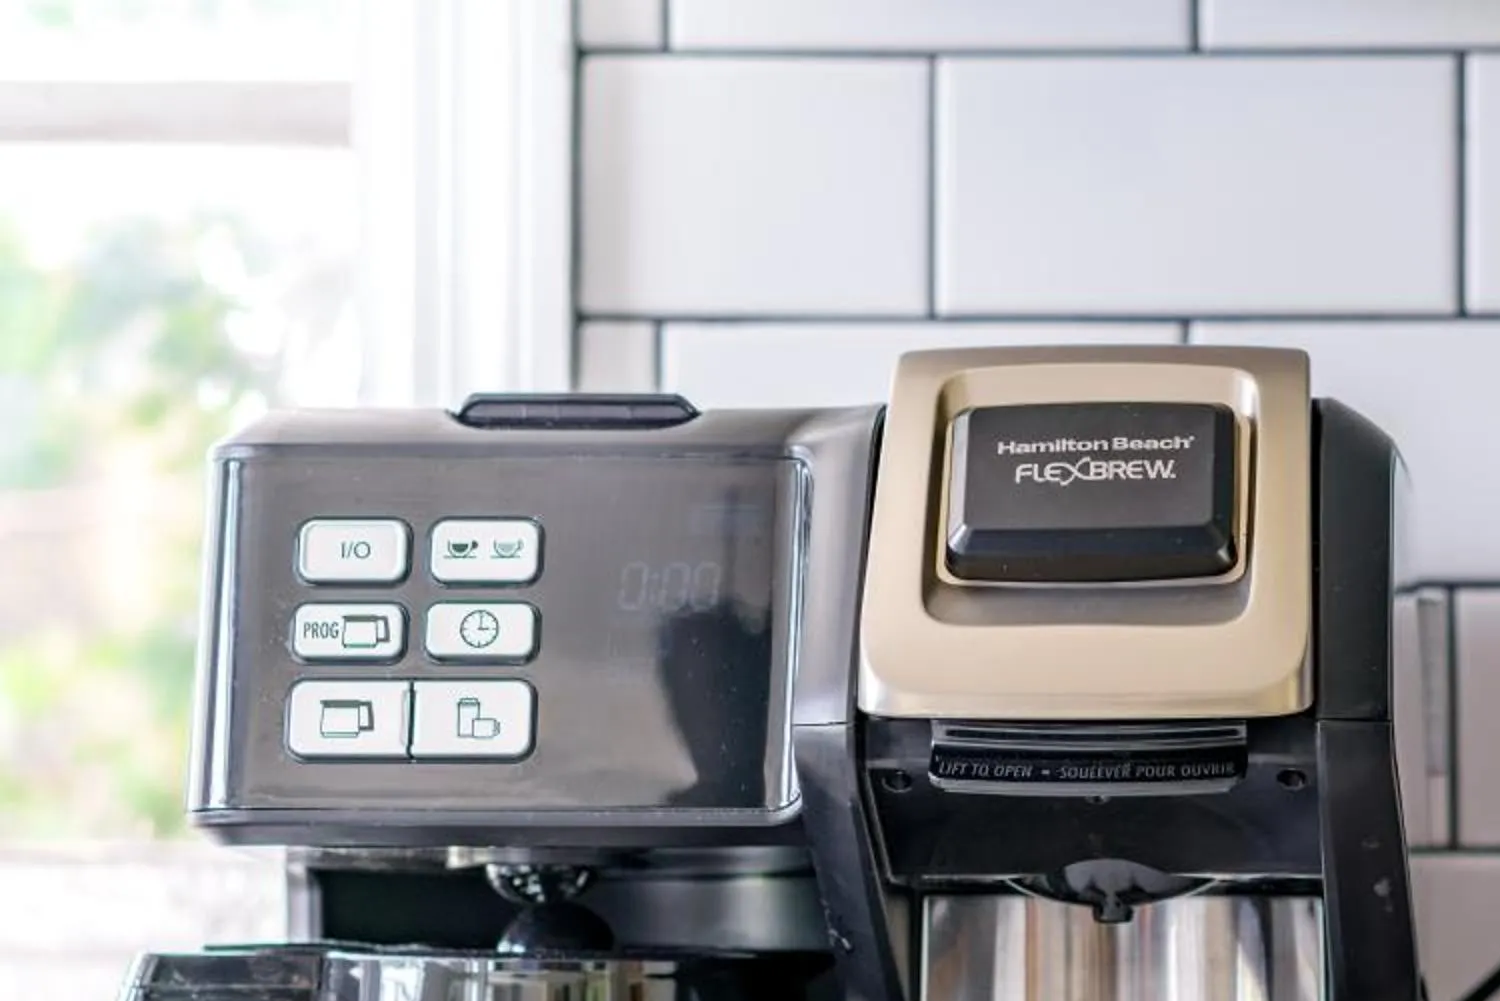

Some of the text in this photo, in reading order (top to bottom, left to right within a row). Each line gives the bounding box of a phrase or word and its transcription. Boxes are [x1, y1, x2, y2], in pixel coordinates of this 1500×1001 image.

[997, 437, 1109, 455] Hamilton
[303, 621, 339, 639] PROG
[970, 763, 989, 777] TO
[994, 765, 1034, 778] OPEN
[1136, 764, 1177, 778] POUR
